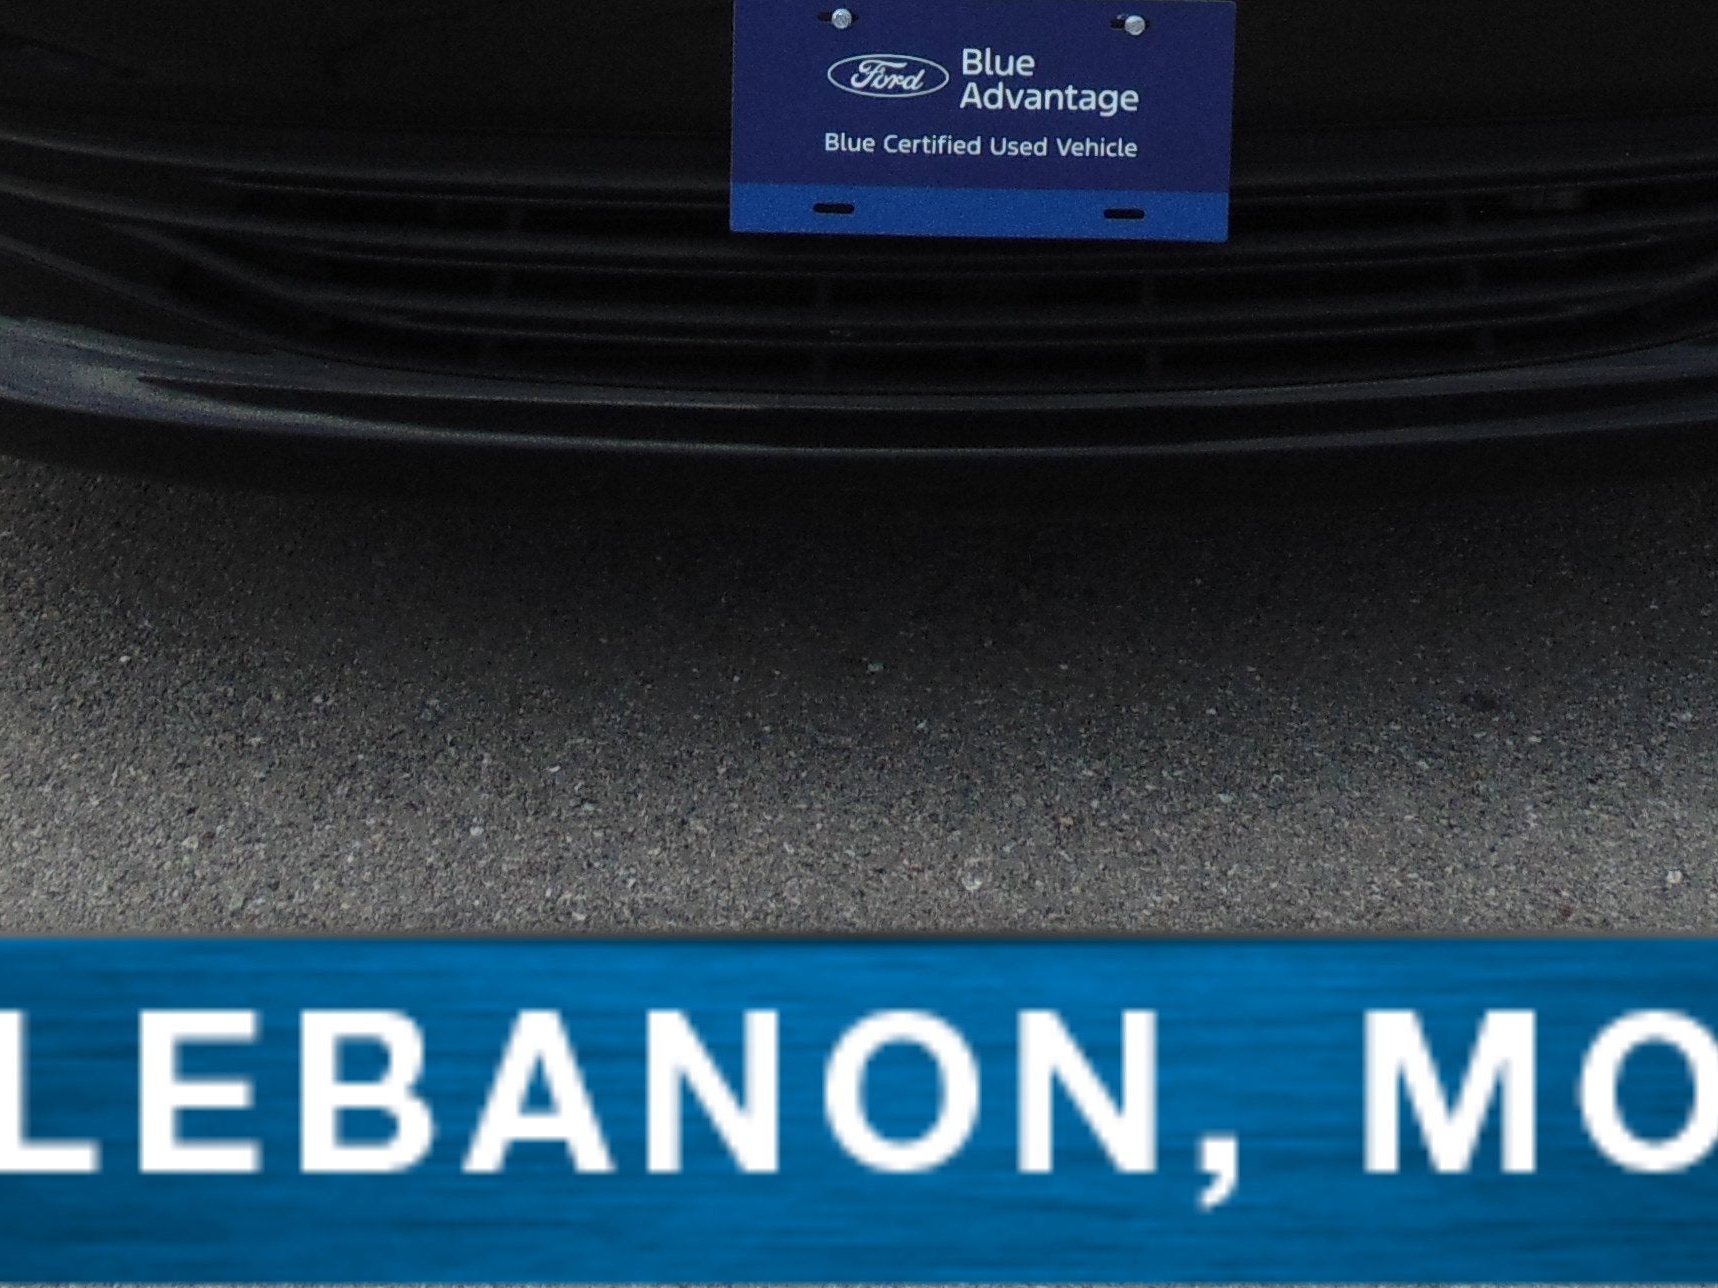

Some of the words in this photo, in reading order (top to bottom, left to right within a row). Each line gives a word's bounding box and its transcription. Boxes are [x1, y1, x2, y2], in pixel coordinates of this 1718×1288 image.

[850, 59, 926, 92] Ford
[962, 47, 1035, 77] Blue
[959, 81, 1140, 118] Advantage
[825, 131, 876, 153] Blue
[884, 133, 982, 156] Certified
[990, 135, 1048, 157] Used
[1056, 136, 1139, 159] Vehicle
